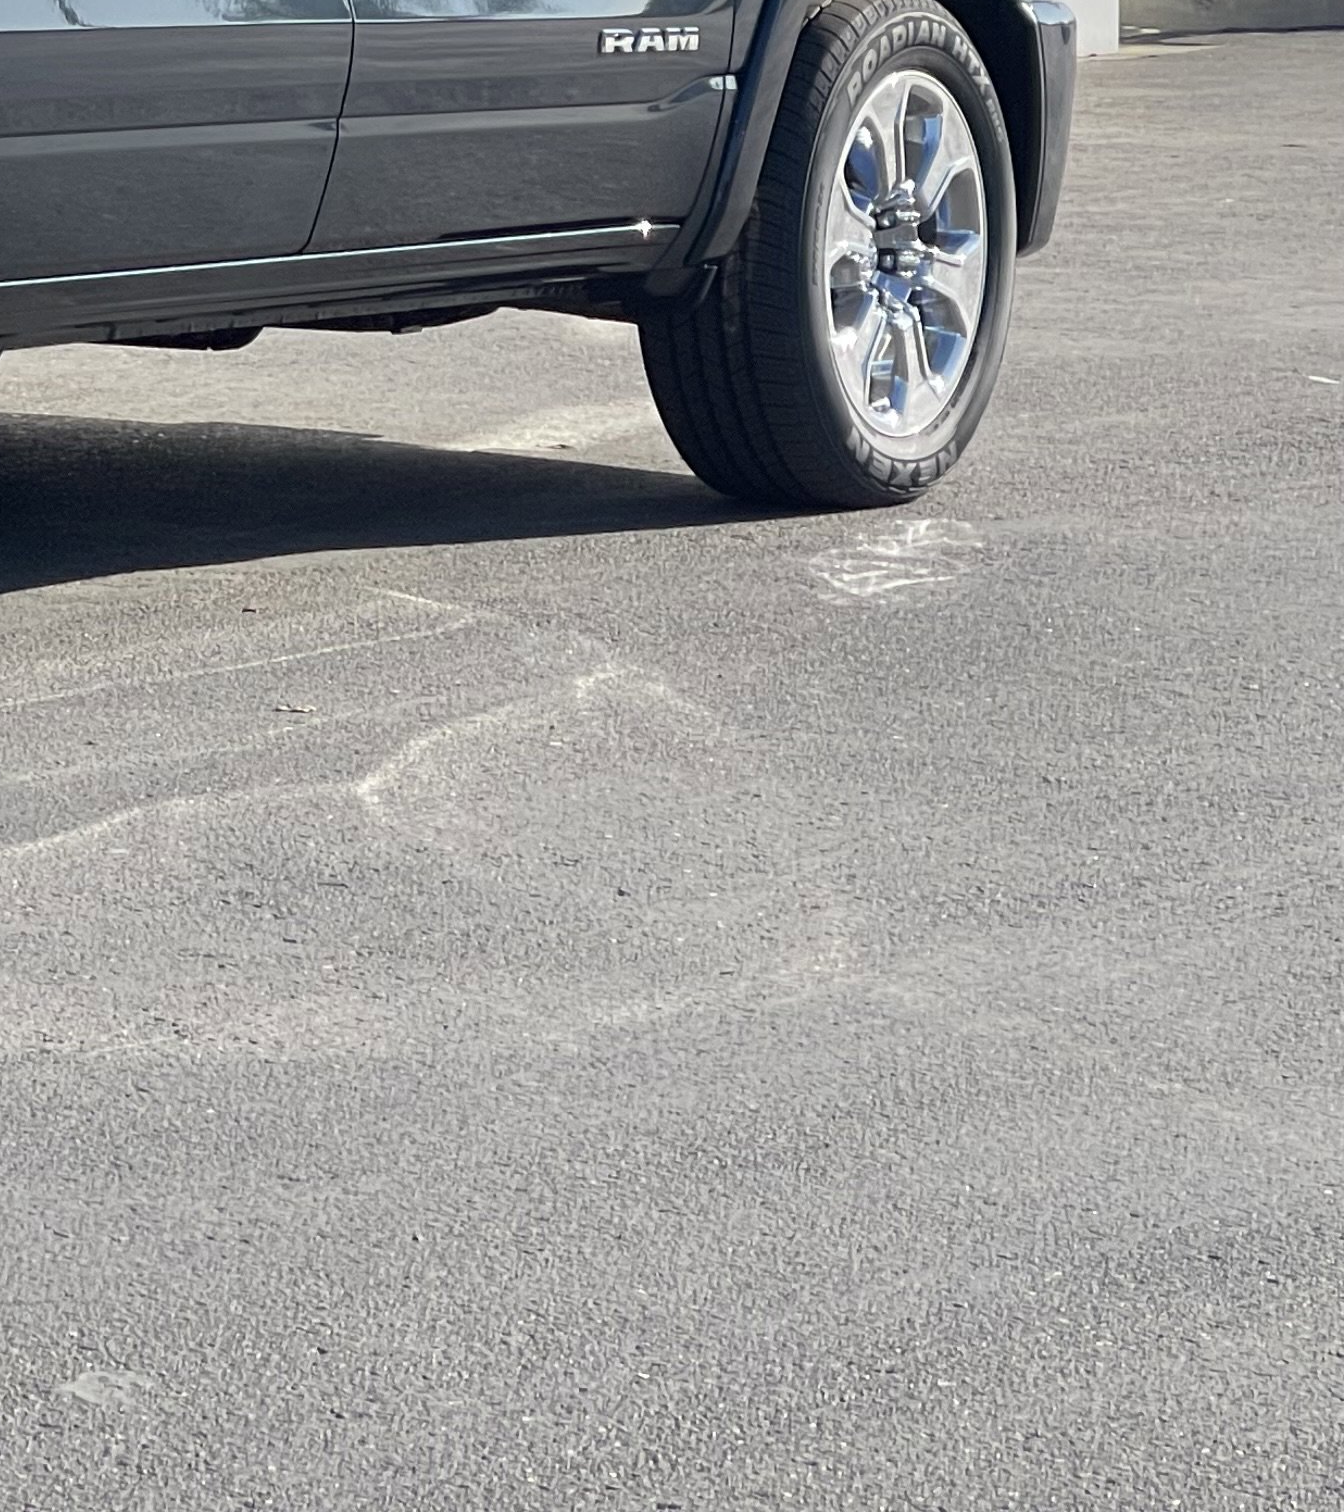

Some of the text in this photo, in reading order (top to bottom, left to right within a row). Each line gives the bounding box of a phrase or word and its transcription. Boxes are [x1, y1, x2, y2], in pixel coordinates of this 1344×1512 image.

[598, 27, 700, 54] RAM
[952, 35, 991, 96] HTX
[846, 425, 958, 487] NEXEN
